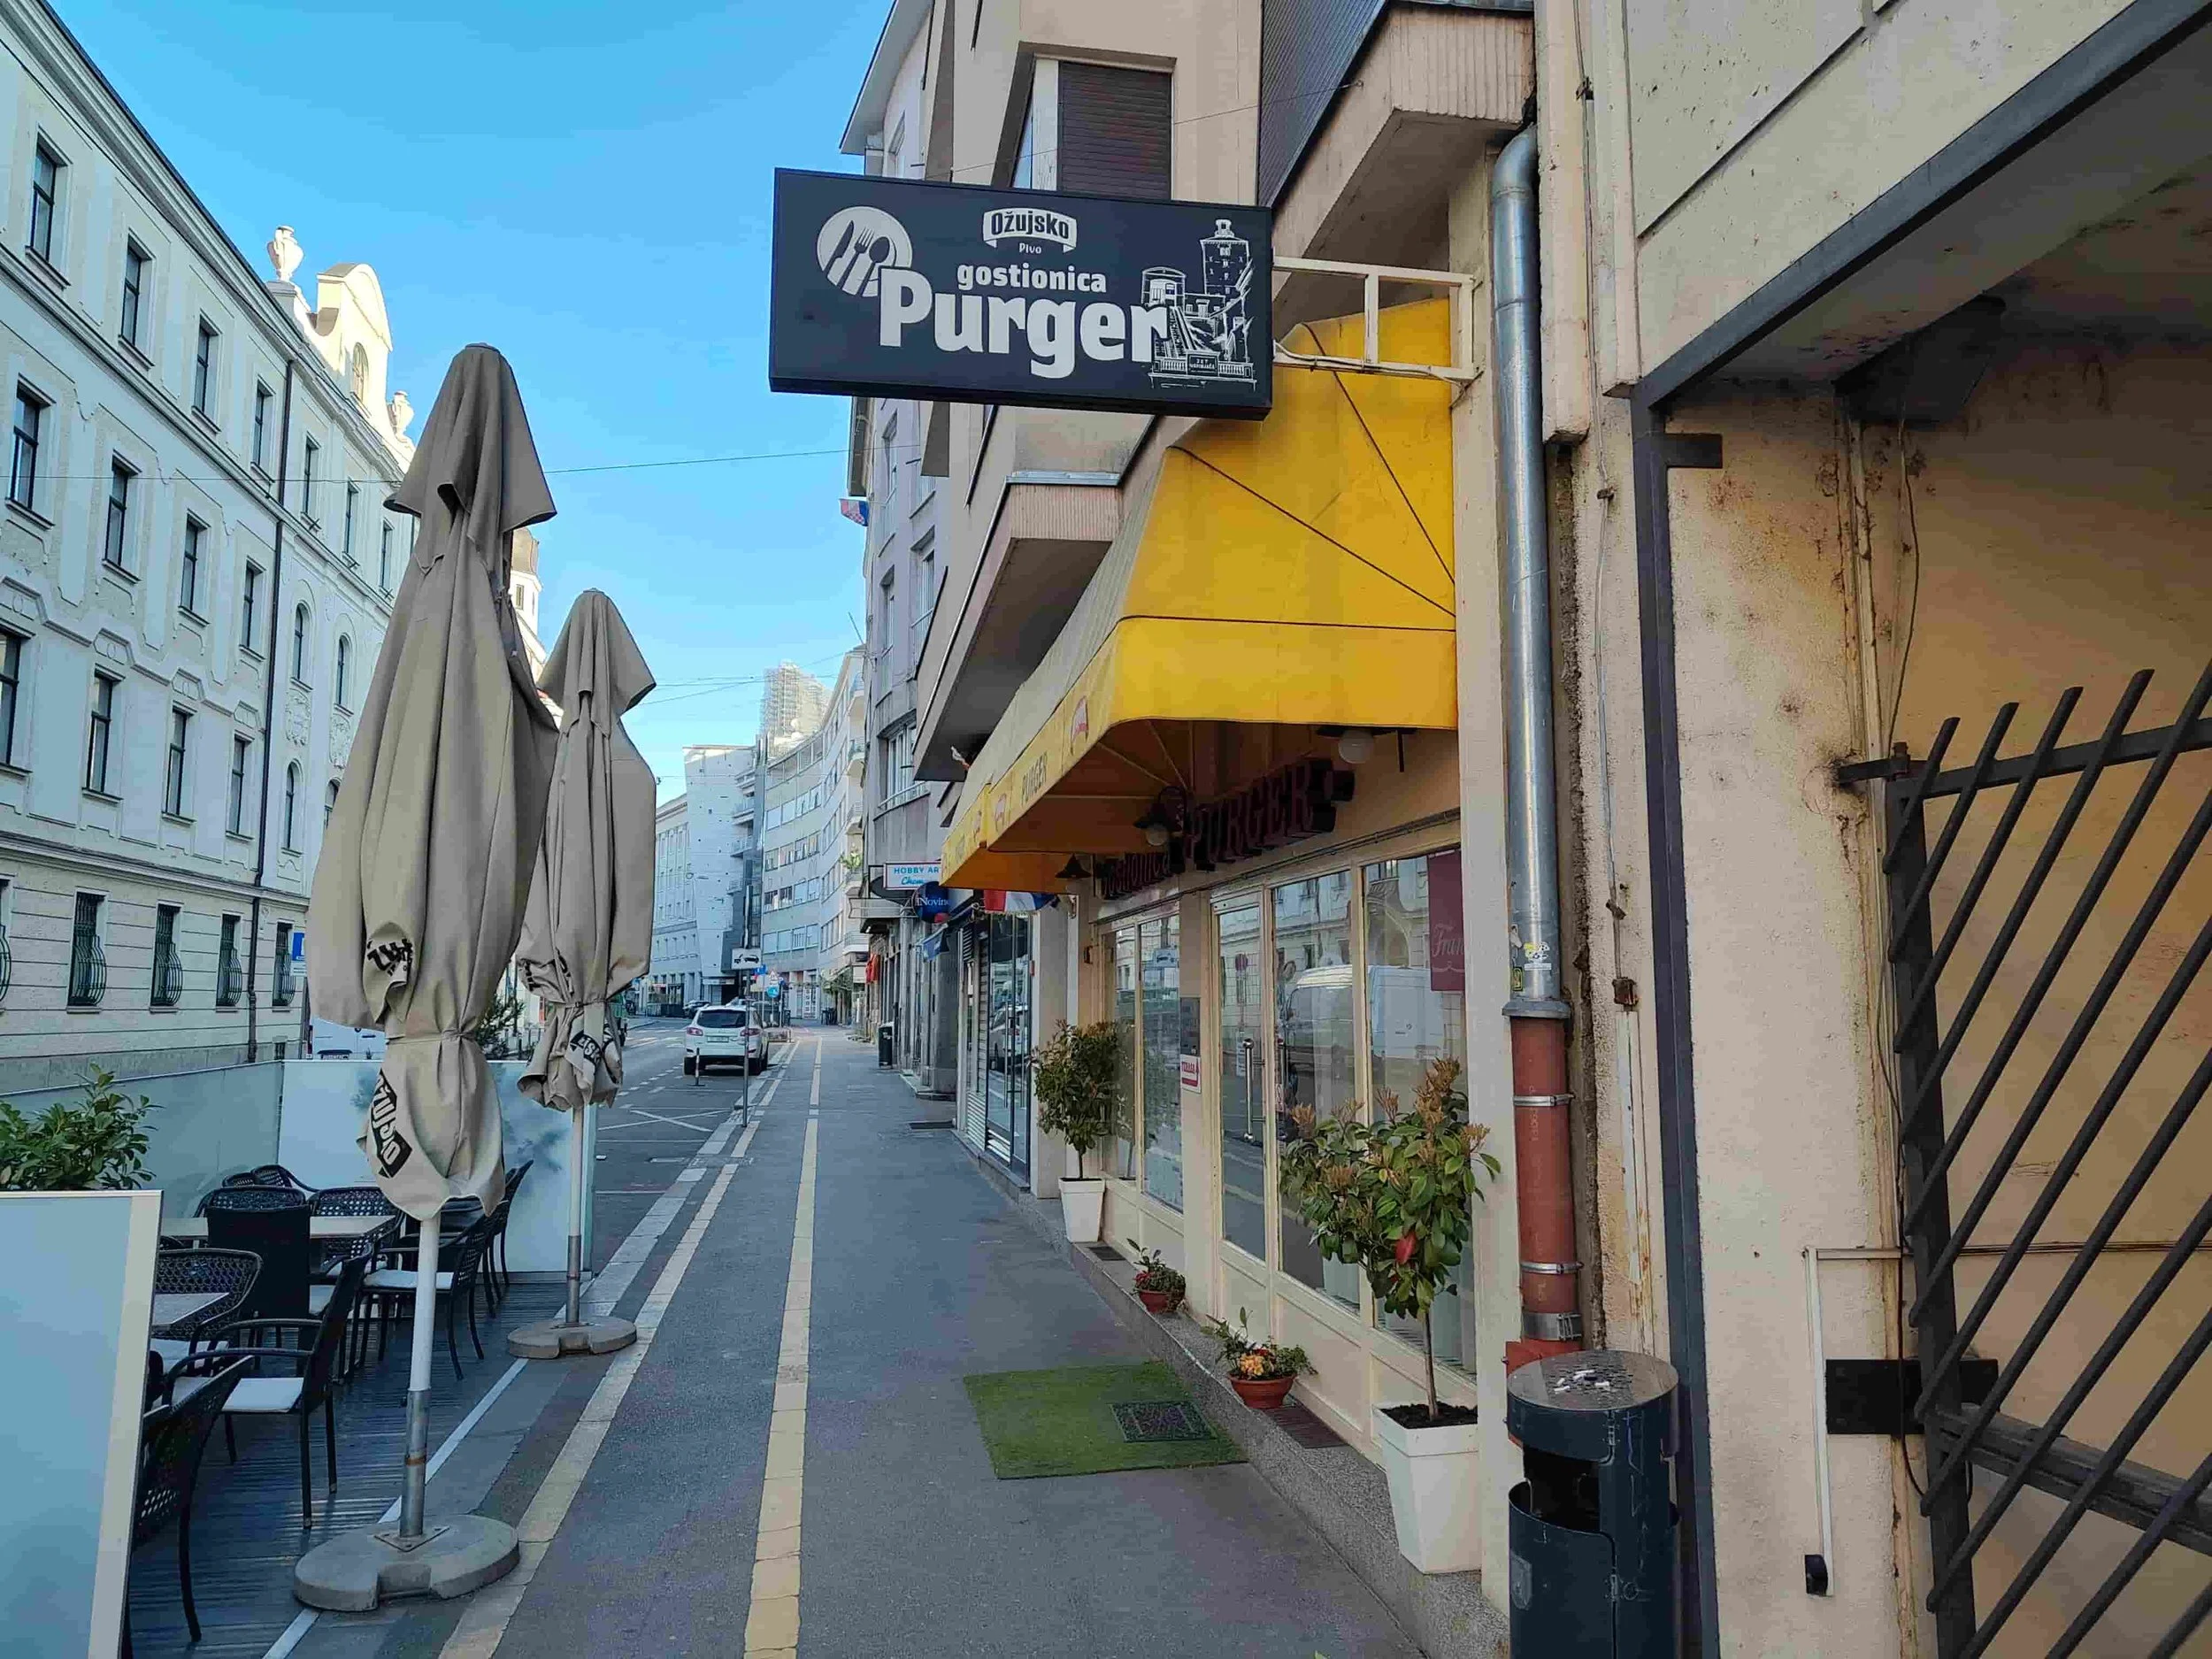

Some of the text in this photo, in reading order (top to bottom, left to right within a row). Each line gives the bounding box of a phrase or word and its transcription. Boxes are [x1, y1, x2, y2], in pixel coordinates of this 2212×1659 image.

[991, 211, 1069, 239] Ožujsko
[956, 262, 1107, 293] gostionica
[879, 266, 1168, 380] Purger
